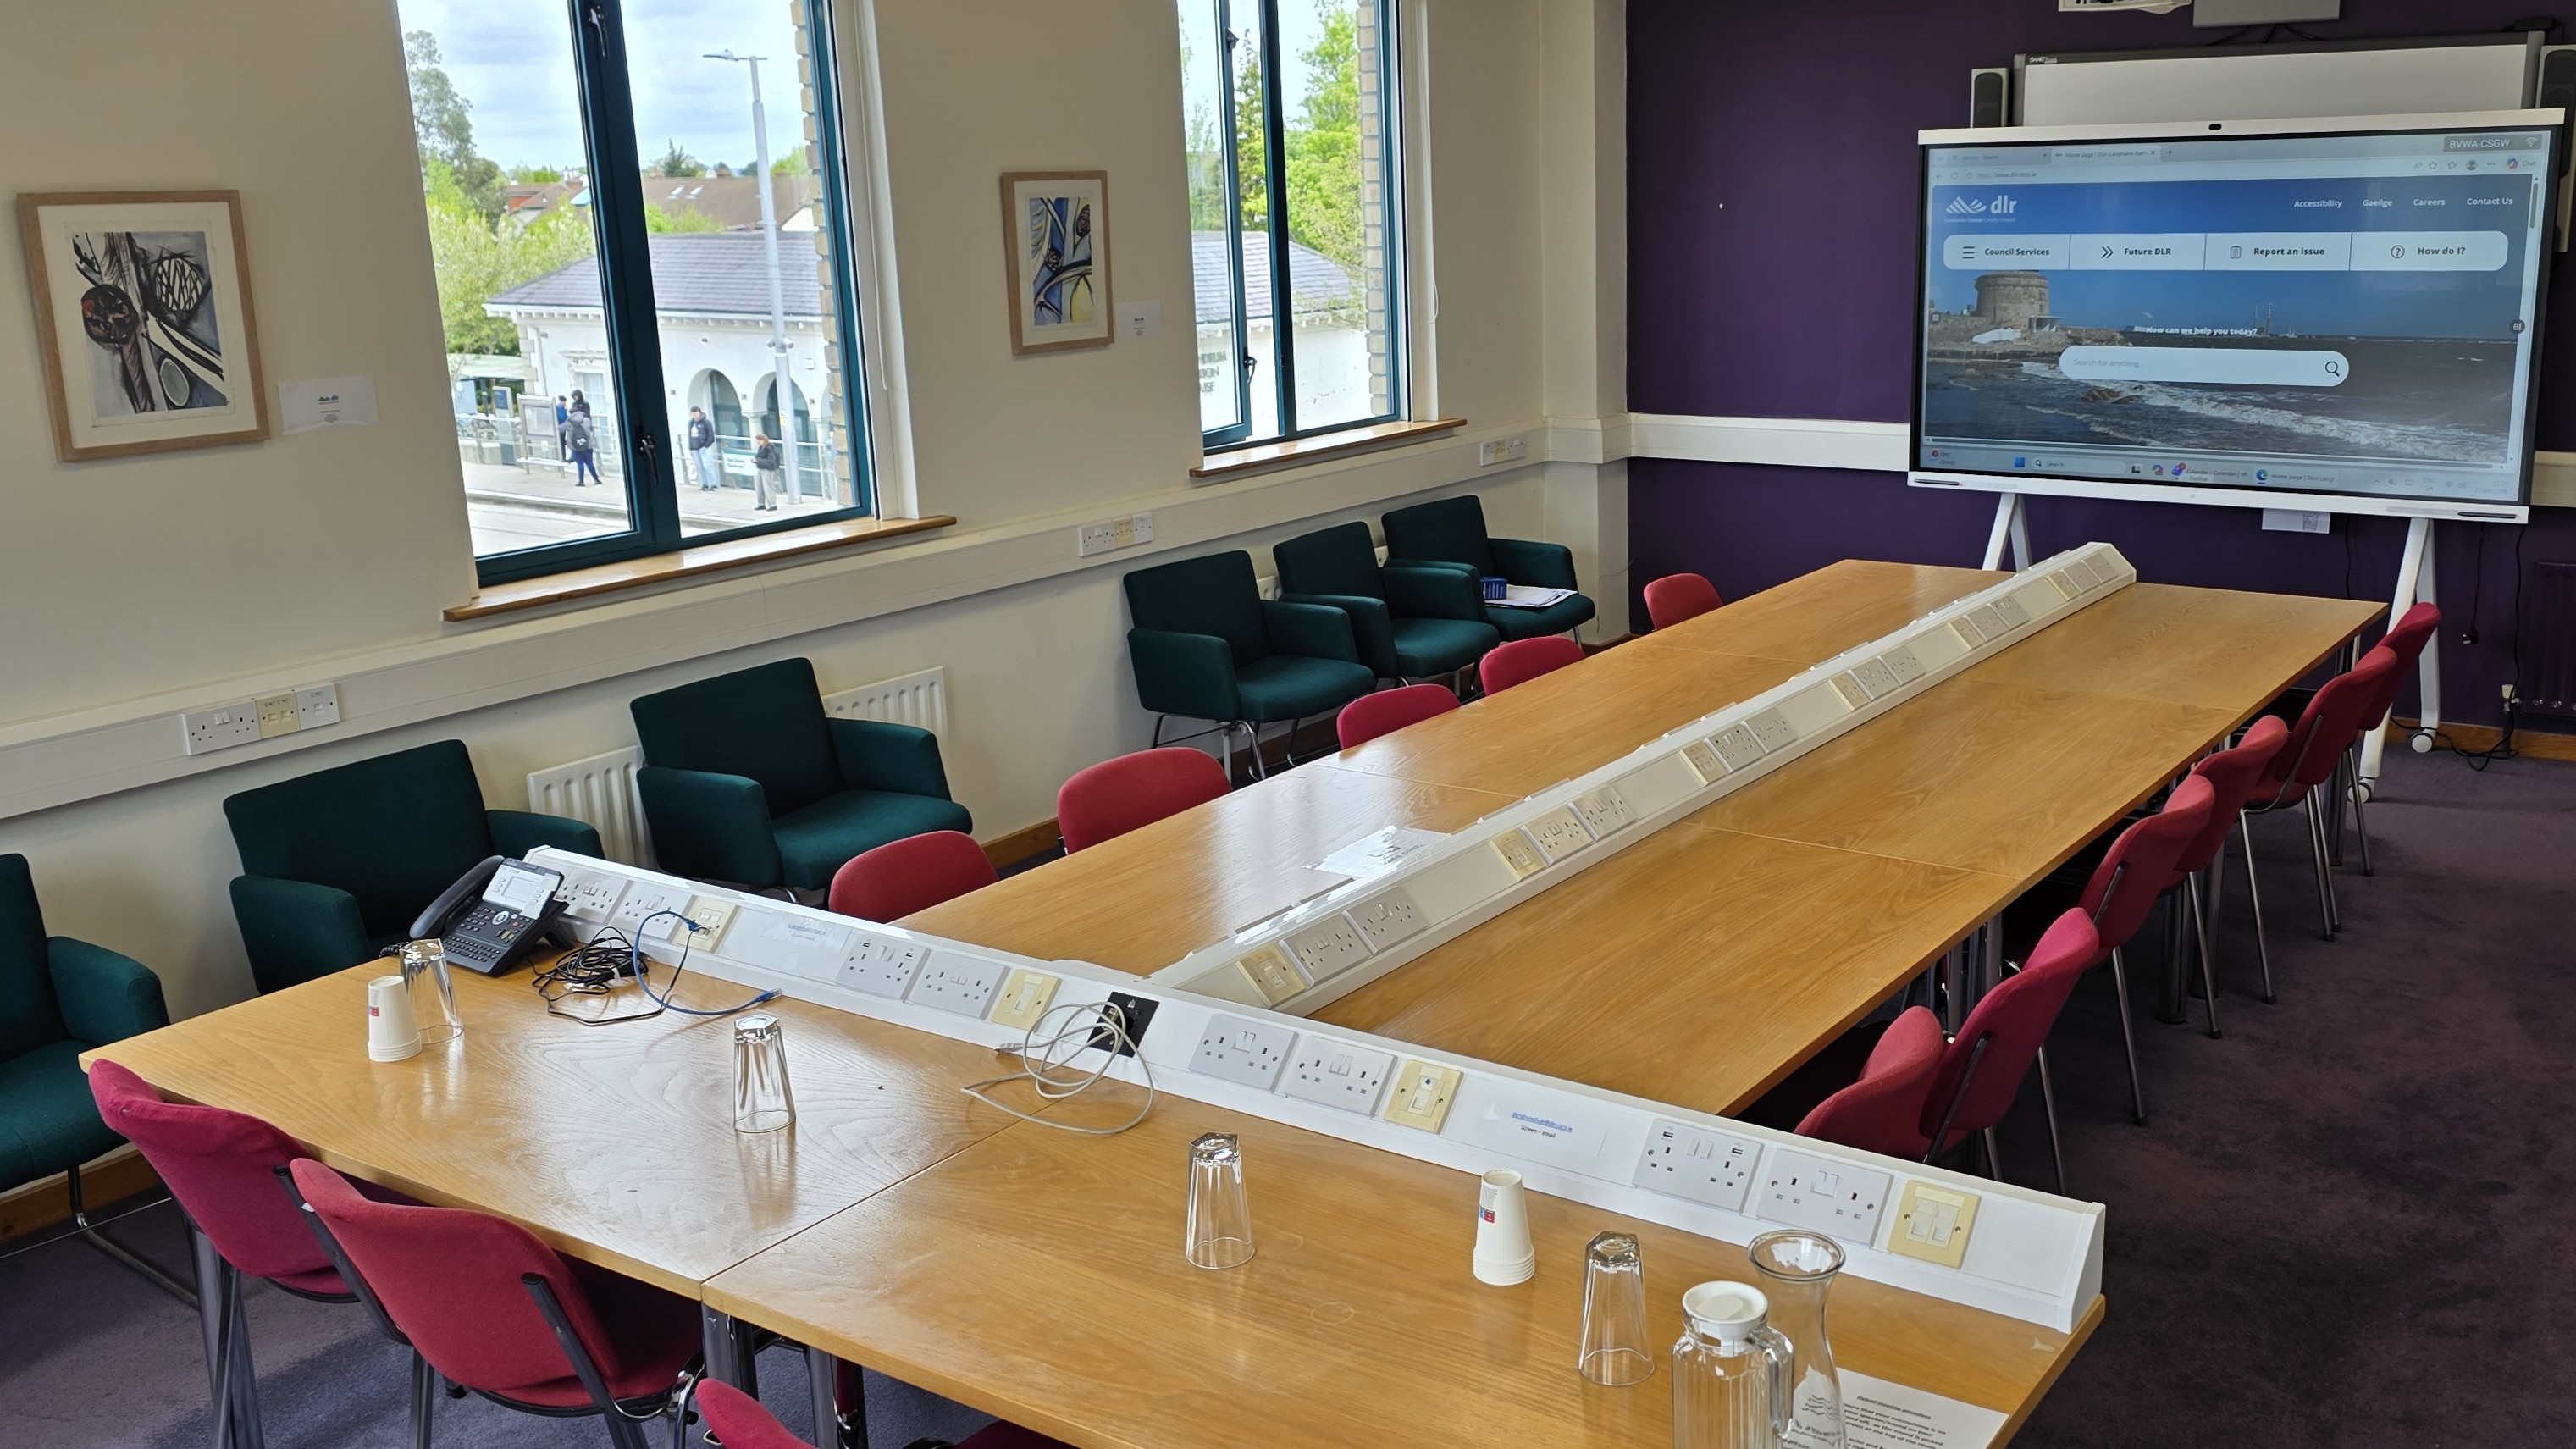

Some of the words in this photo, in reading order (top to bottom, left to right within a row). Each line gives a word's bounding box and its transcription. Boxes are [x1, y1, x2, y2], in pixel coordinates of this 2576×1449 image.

[2450, 139, 2511, 148] BVWA-CSGW
[1990, 195, 2017, 213] dlr
[2294, 199, 2343, 208] Accessibility
[2363, 199, 2393, 207] Gaeilge
[2467, 197, 2500, 206] Contact
[2253, 247, 2285, 257] Report
[2230, 328, 2258, 337] today?
